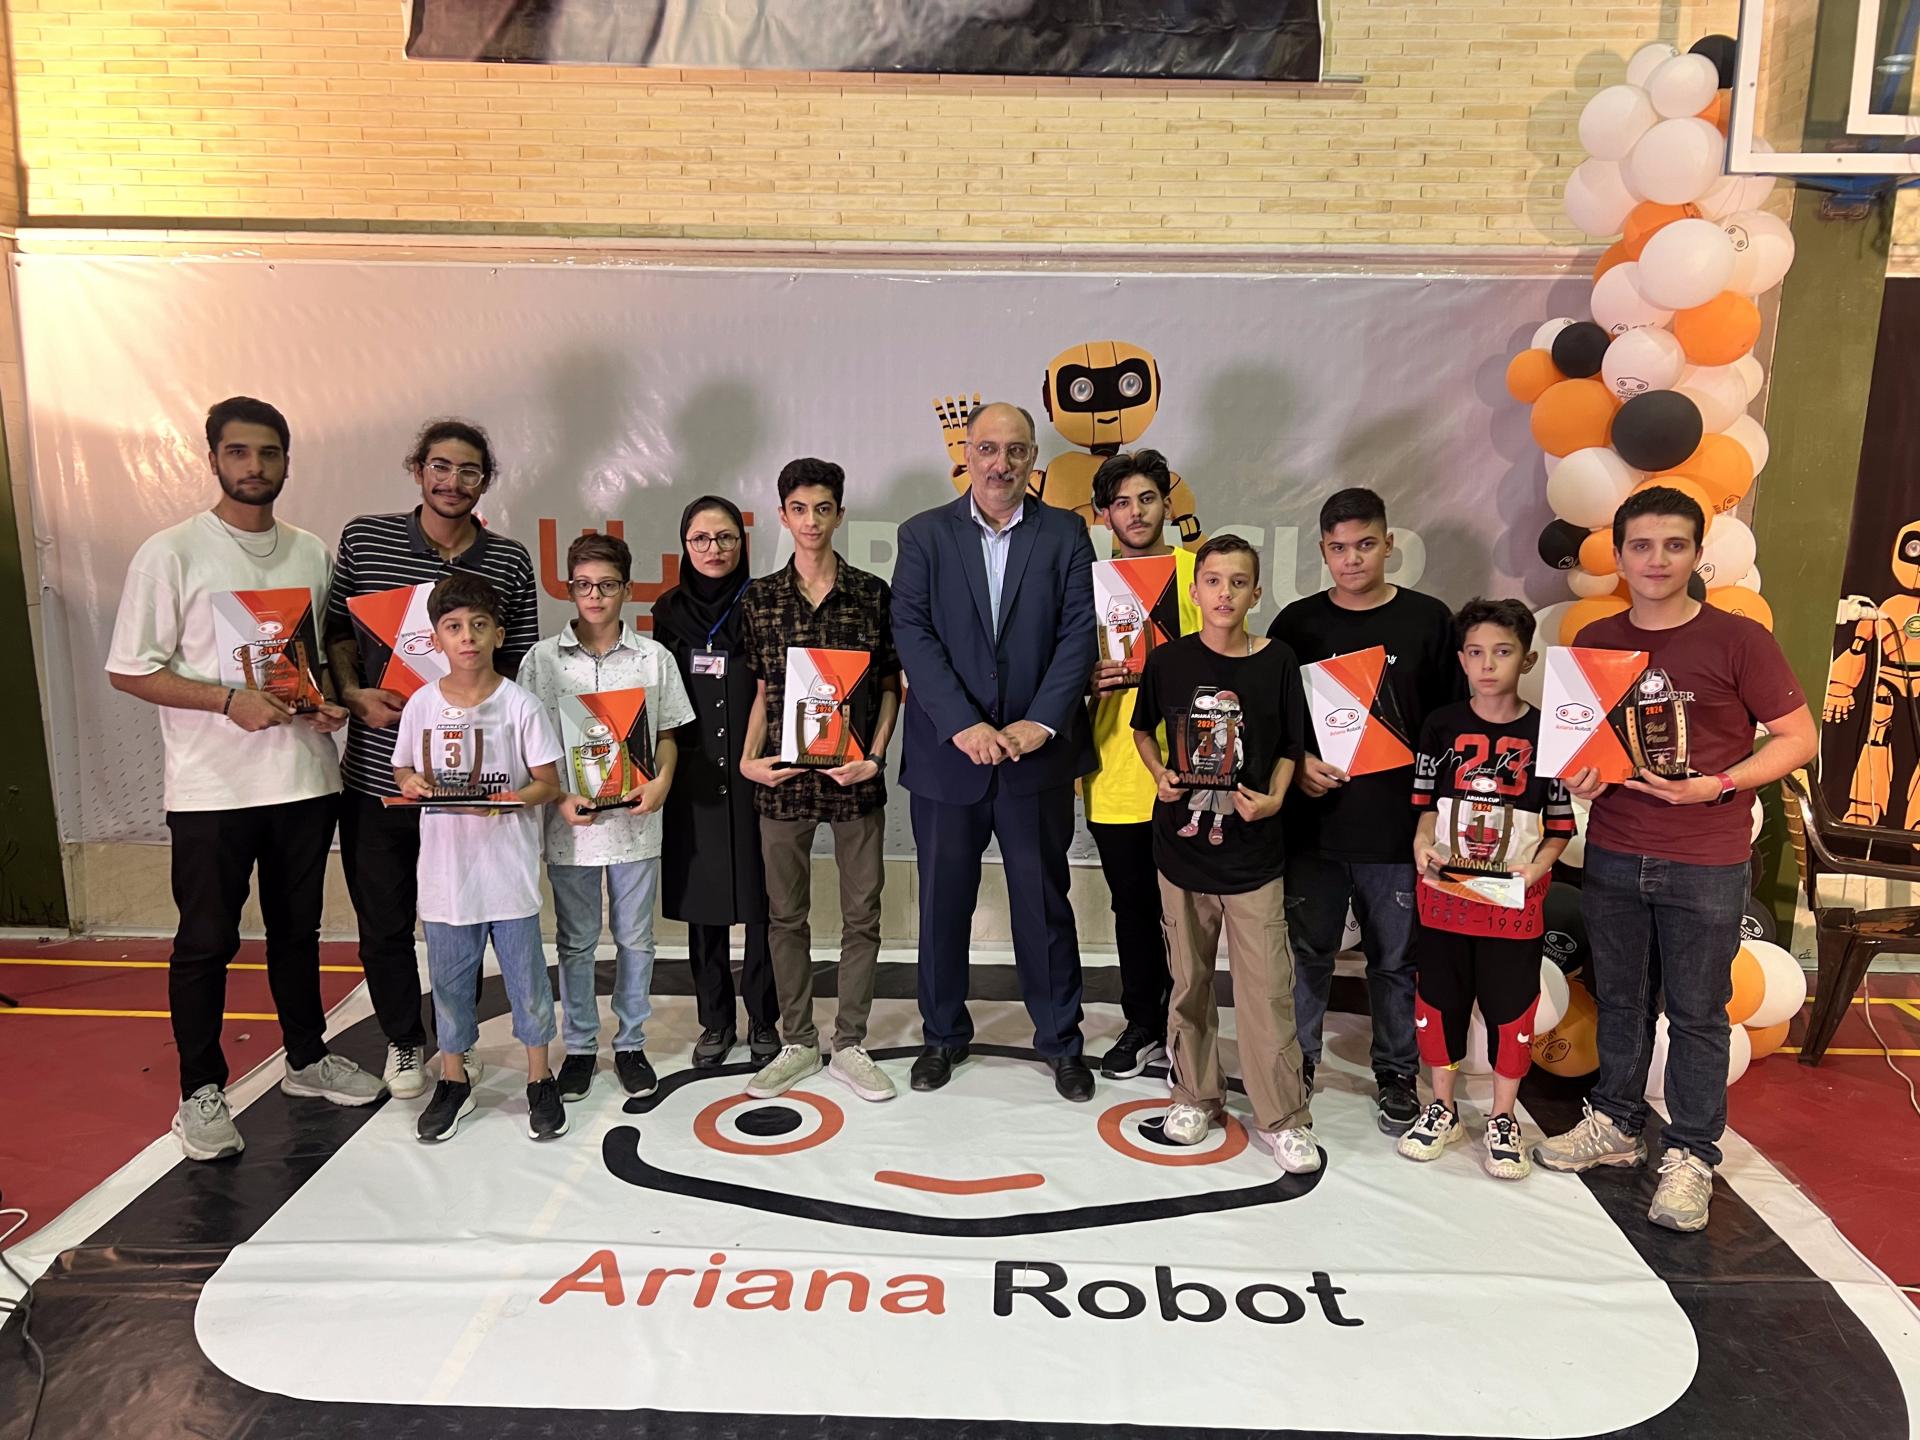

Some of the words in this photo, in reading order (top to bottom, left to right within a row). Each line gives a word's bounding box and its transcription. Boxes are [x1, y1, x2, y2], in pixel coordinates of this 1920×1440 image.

[1119, 635, 1132, 659] 1
[1645, 705, 1664, 715] 2024
[443, 731, 464, 740] 2024
[816, 716, 828, 739] 1
[1197, 720, 1216, 728] 2024
[445, 742, 462, 768] 3
[1454, 733, 1533, 797] 23
[1472, 804, 1492, 812] 2024
[1473, 815, 1485, 844] 1
[538, 1250, 945, 1316] Ariana
[993, 1260, 1364, 1327] Robot
